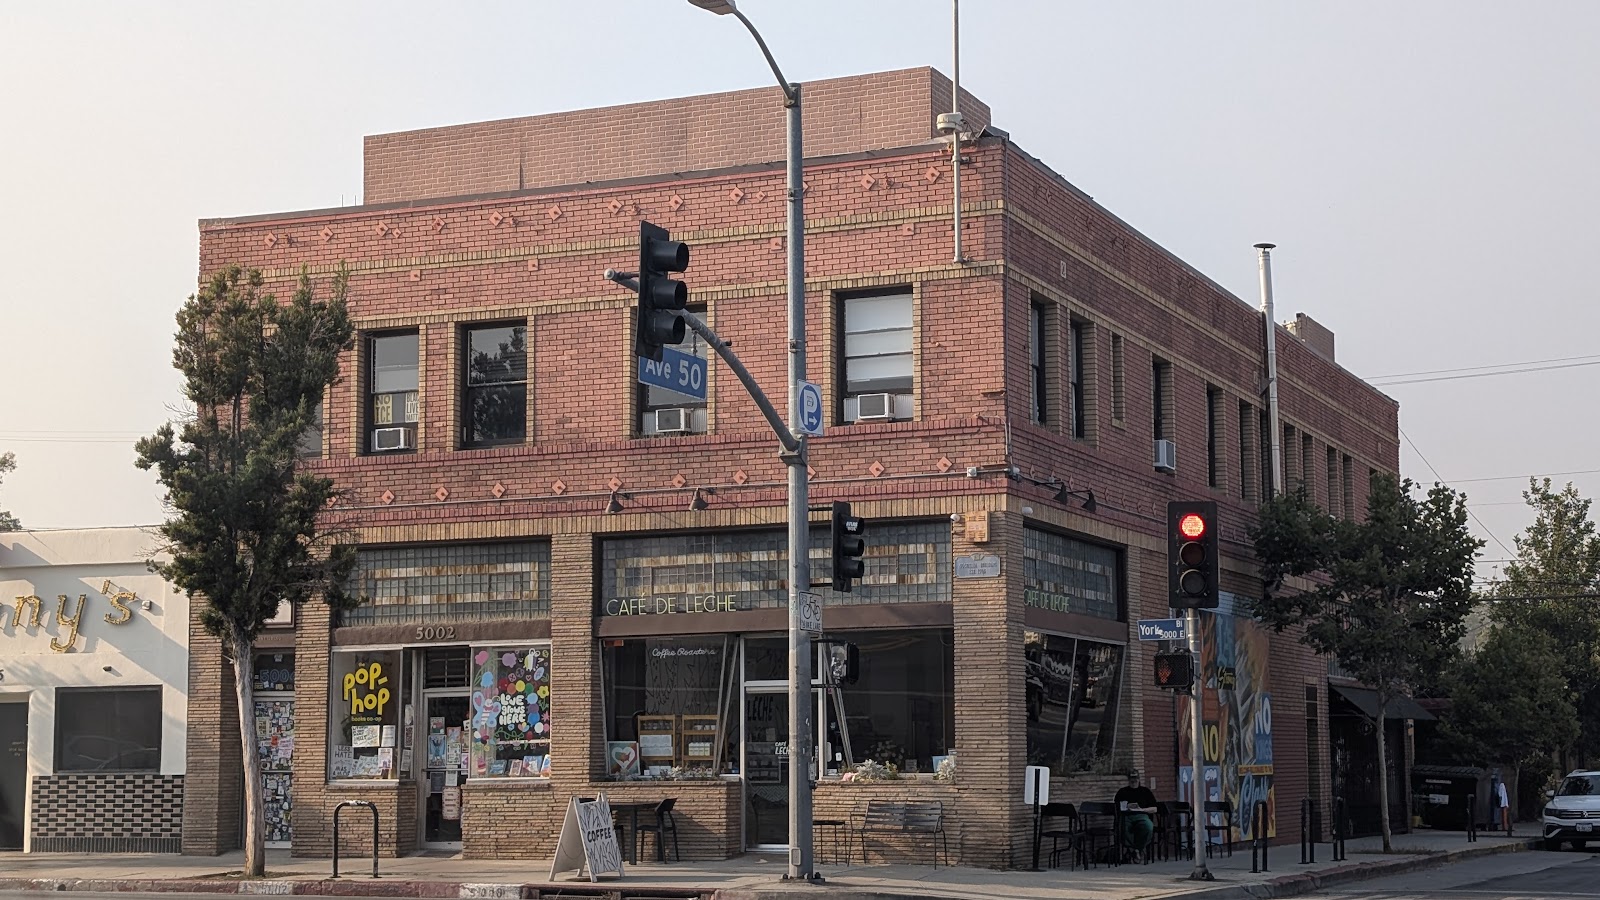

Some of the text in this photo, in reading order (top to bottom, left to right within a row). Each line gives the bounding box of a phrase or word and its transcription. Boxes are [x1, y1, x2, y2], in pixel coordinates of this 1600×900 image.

[645, 358, 701, 390] Ave 50
[375, 395, 391, 405] NO
[375, 406, 391, 423] ICE
[606, 592, 737, 616] CAFÉ DE LECHE
[1040, 592, 1050, 610] DE
[1050, 594, 1070, 614] LECHE
[415, 626, 456, 640] 5002
[1139, 624, 1160, 635] York
[1179, 630, 1185, 638] E
[652, 647, 717, 659] Coffee Roasters
[351, 684, 390, 716] hop
[500, 693, 525, 706] LOVE
[501, 704, 525, 716] grows
[1255, 696, 1272, 735] NO
[499, 713, 526, 726] HERE
[1201, 724, 1219, 762] NO
[775, 746, 790, 755] LECH
[586, 826, 612, 843] COFFEE
